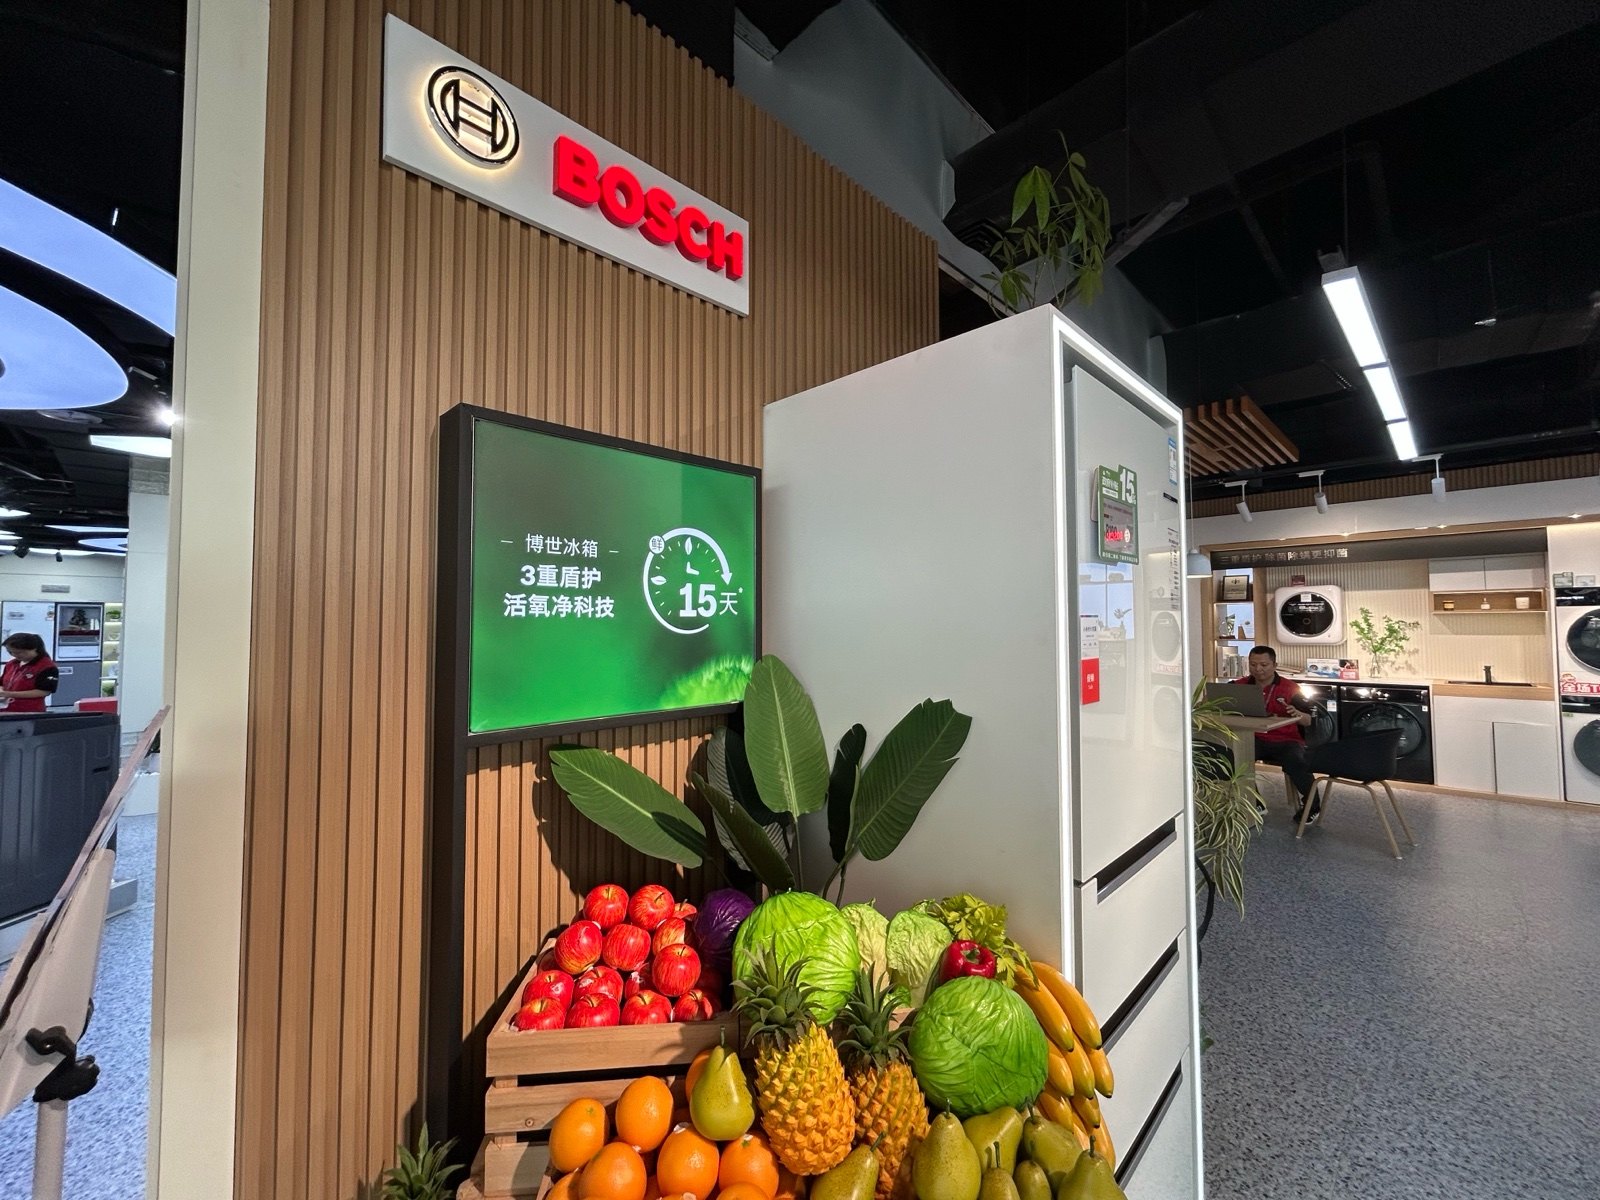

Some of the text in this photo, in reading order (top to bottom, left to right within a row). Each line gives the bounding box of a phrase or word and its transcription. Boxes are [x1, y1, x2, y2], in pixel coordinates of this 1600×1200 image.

[553, 135, 743, 281] BOSCH
[525, 533, 599, 558] 博世冰箱
[651, 538, 664, 552] 鲜
[520, 564, 601, 589] 3重盾护
[503, 592, 615, 618] 活氧净科技
